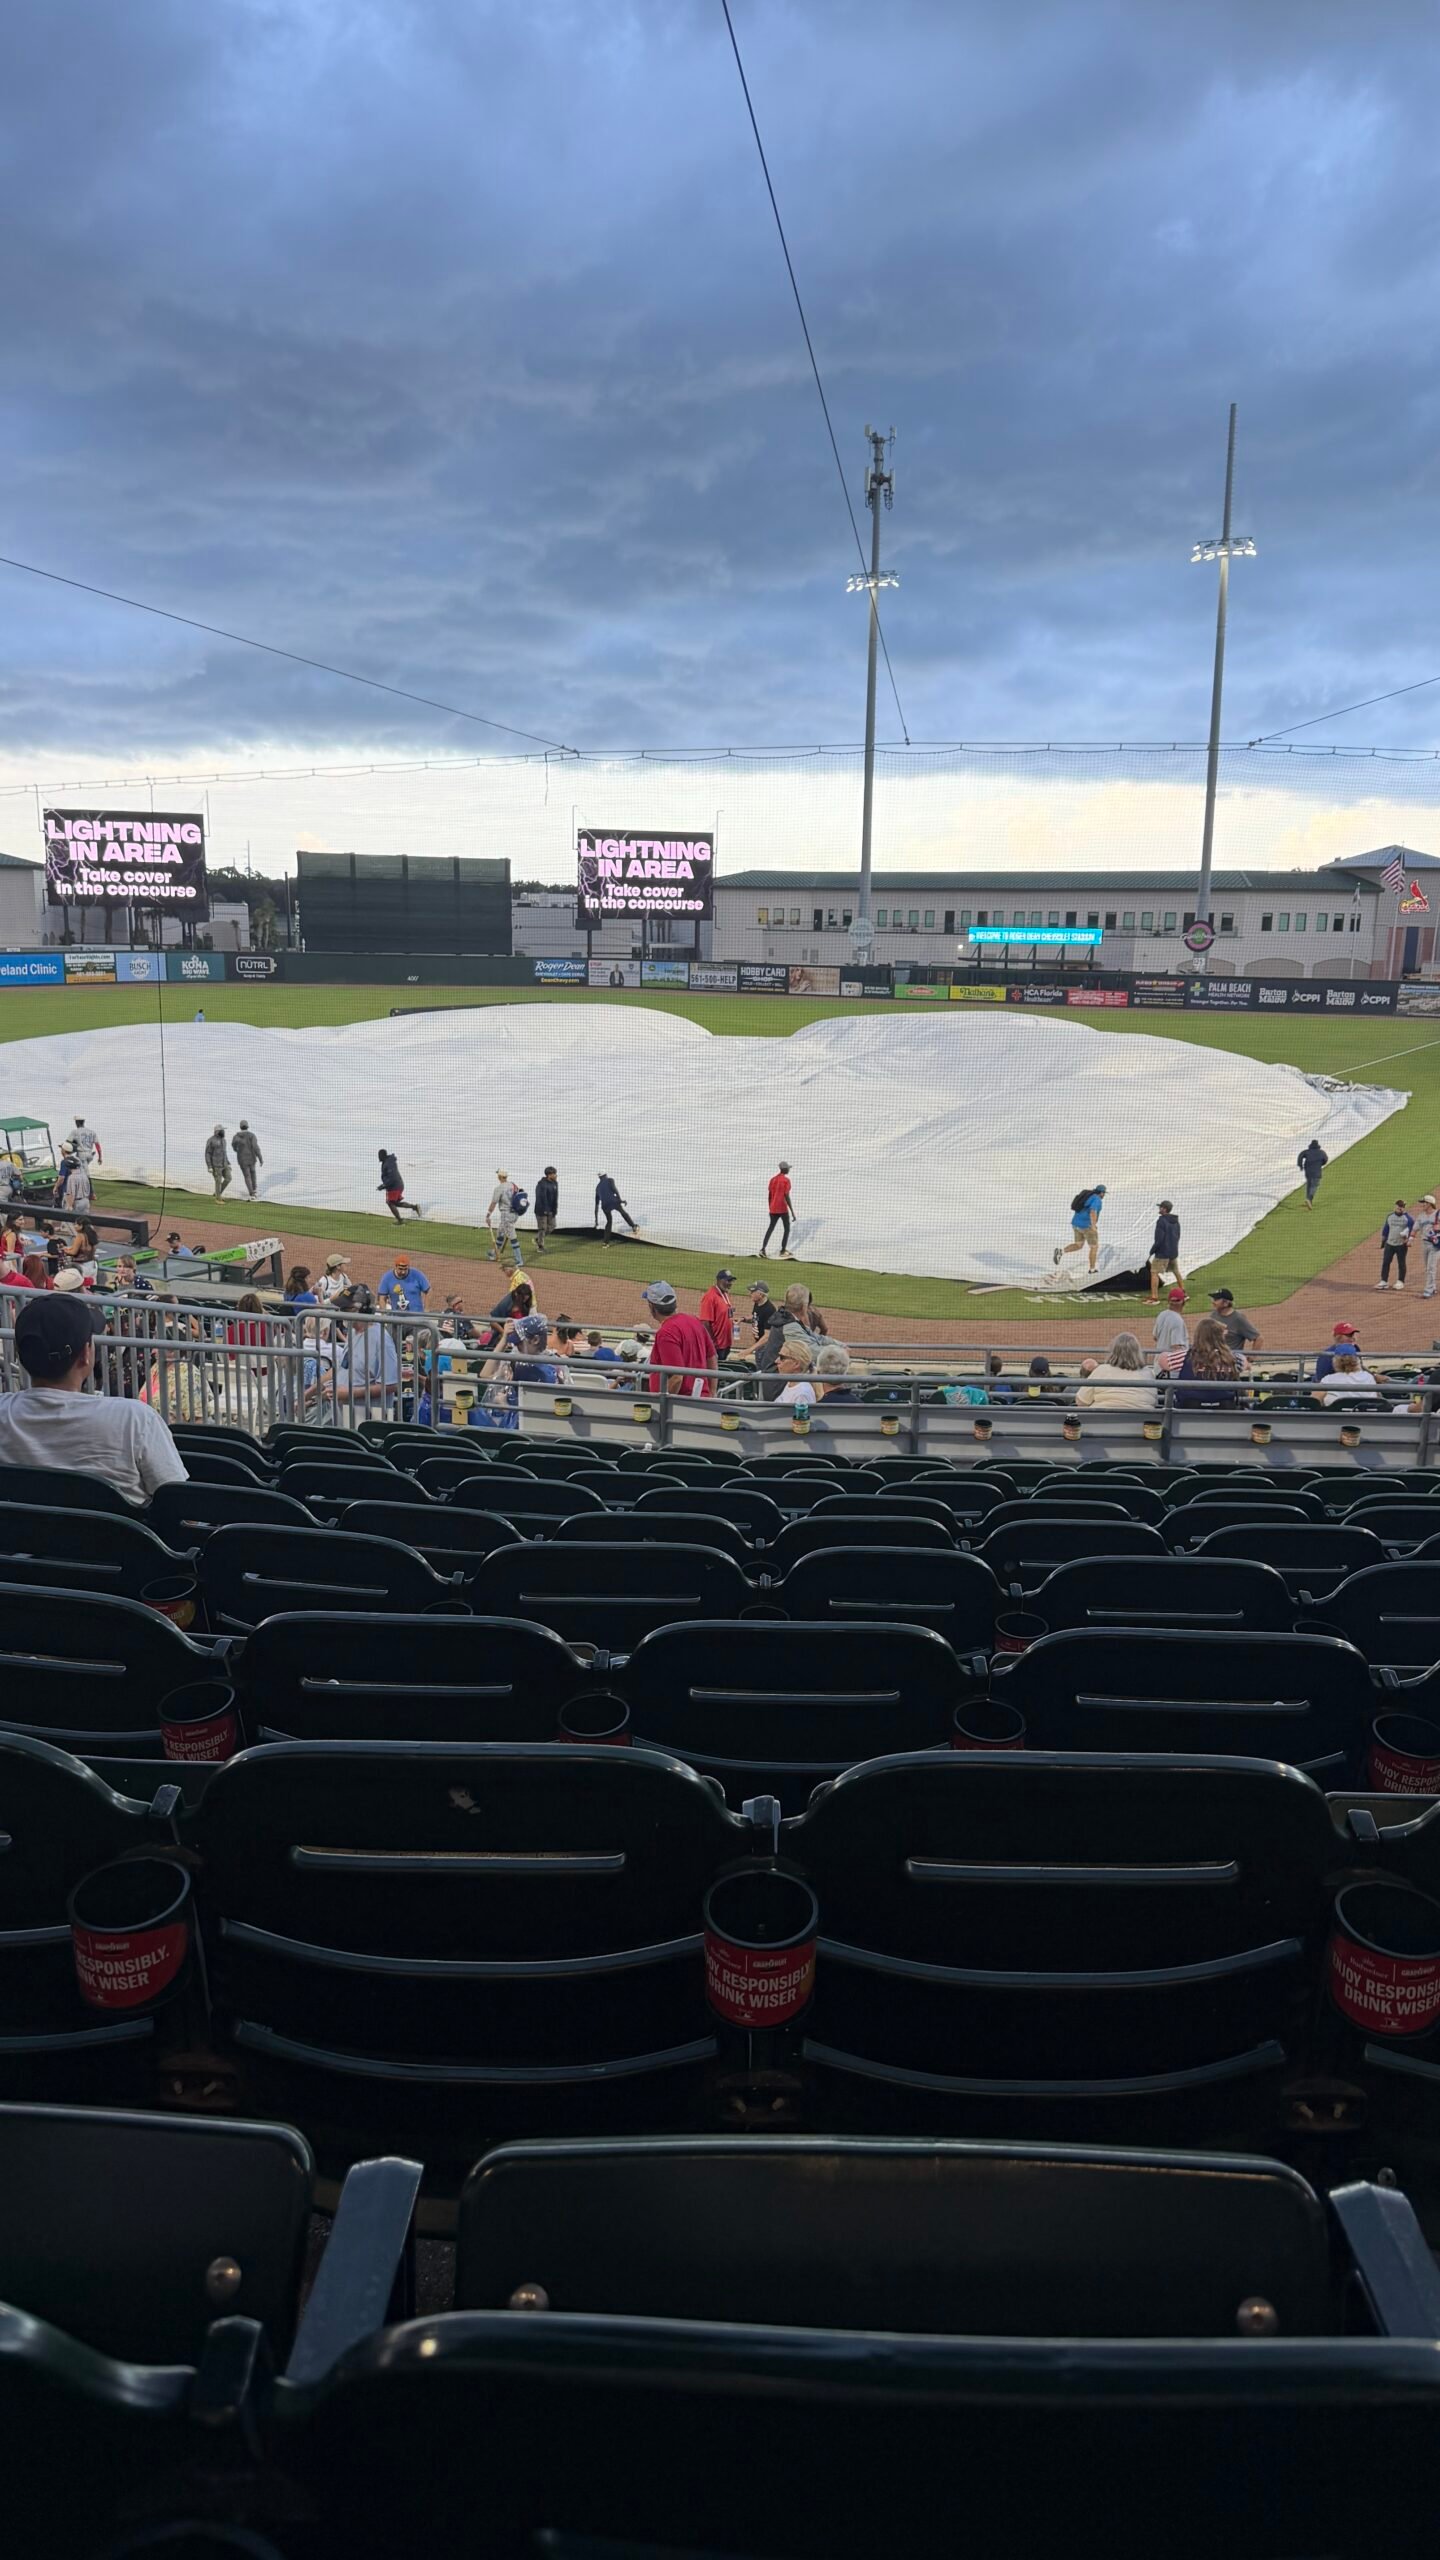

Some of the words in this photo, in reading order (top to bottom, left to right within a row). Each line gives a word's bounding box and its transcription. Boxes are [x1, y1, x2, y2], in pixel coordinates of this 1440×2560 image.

[47, 820, 202, 844] LIGHTNING
[69, 841, 98, 861] IN
[103, 842, 183, 864] AREA
[580, 838, 711, 861] LIGHTNING
[597, 858, 622, 877] IN
[626, 860, 694, 879] AREA
[80, 868, 120, 882] Take
[123, 871, 172, 884] cover
[56, 880, 72, 895] in
[74, 881, 104, 896] the
[106, 884, 196, 898] concourse
[605, 884, 641, 897] Take
[643, 886, 684, 898] cover
[585, 895, 599, 908] in
[601, 896, 626, 909] the
[628, 898, 704, 911] concourse
[0, 963, 28, 976] eland
[30, 963, 58, 976] Clinic
[129, 961, 151, 971] BUSCH
[240, 959, 269, 970] NÜTRL
[535, 960, 563, 973] Roger
[564, 961, 585, 971] Dean
[740, 966, 764, 977] HOBBY
[766, 967, 786, 978] CARD
[691, 974, 736, 986] 561-500-HELP
[960, 987, 995, 997] Nathan's
[1024, 989, 1039, 997] HCA
[1040, 989, 1063, 997] Florida
[1209, 982, 1227, 993] PALM
[1229, 983, 1252, 993] BEACH
[1259, 988, 1287, 996] Barton
[1327, 989, 1355, 998] Barton
[1258, 995, 1286, 1004] Malow
[1300, 993, 1320, 1003] CPPI
[1325, 997, 1354, 1006] Malow
[1369, 995, 1391, 1005] CPPI
[187, 1747, 219, 1761] WISER
[1374, 1758, 1399, 1781] ENJOY
[1384, 1778, 1416, 1794] DRINK
[98, 1971, 150, 1991] WISER
[709, 1972, 746, 2006] DRINK
[749, 1987, 798, 2009] WISER
[1365, 1977, 1440, 2001] RESPONSI
[1344, 1983, 1393, 2015] DRINK
